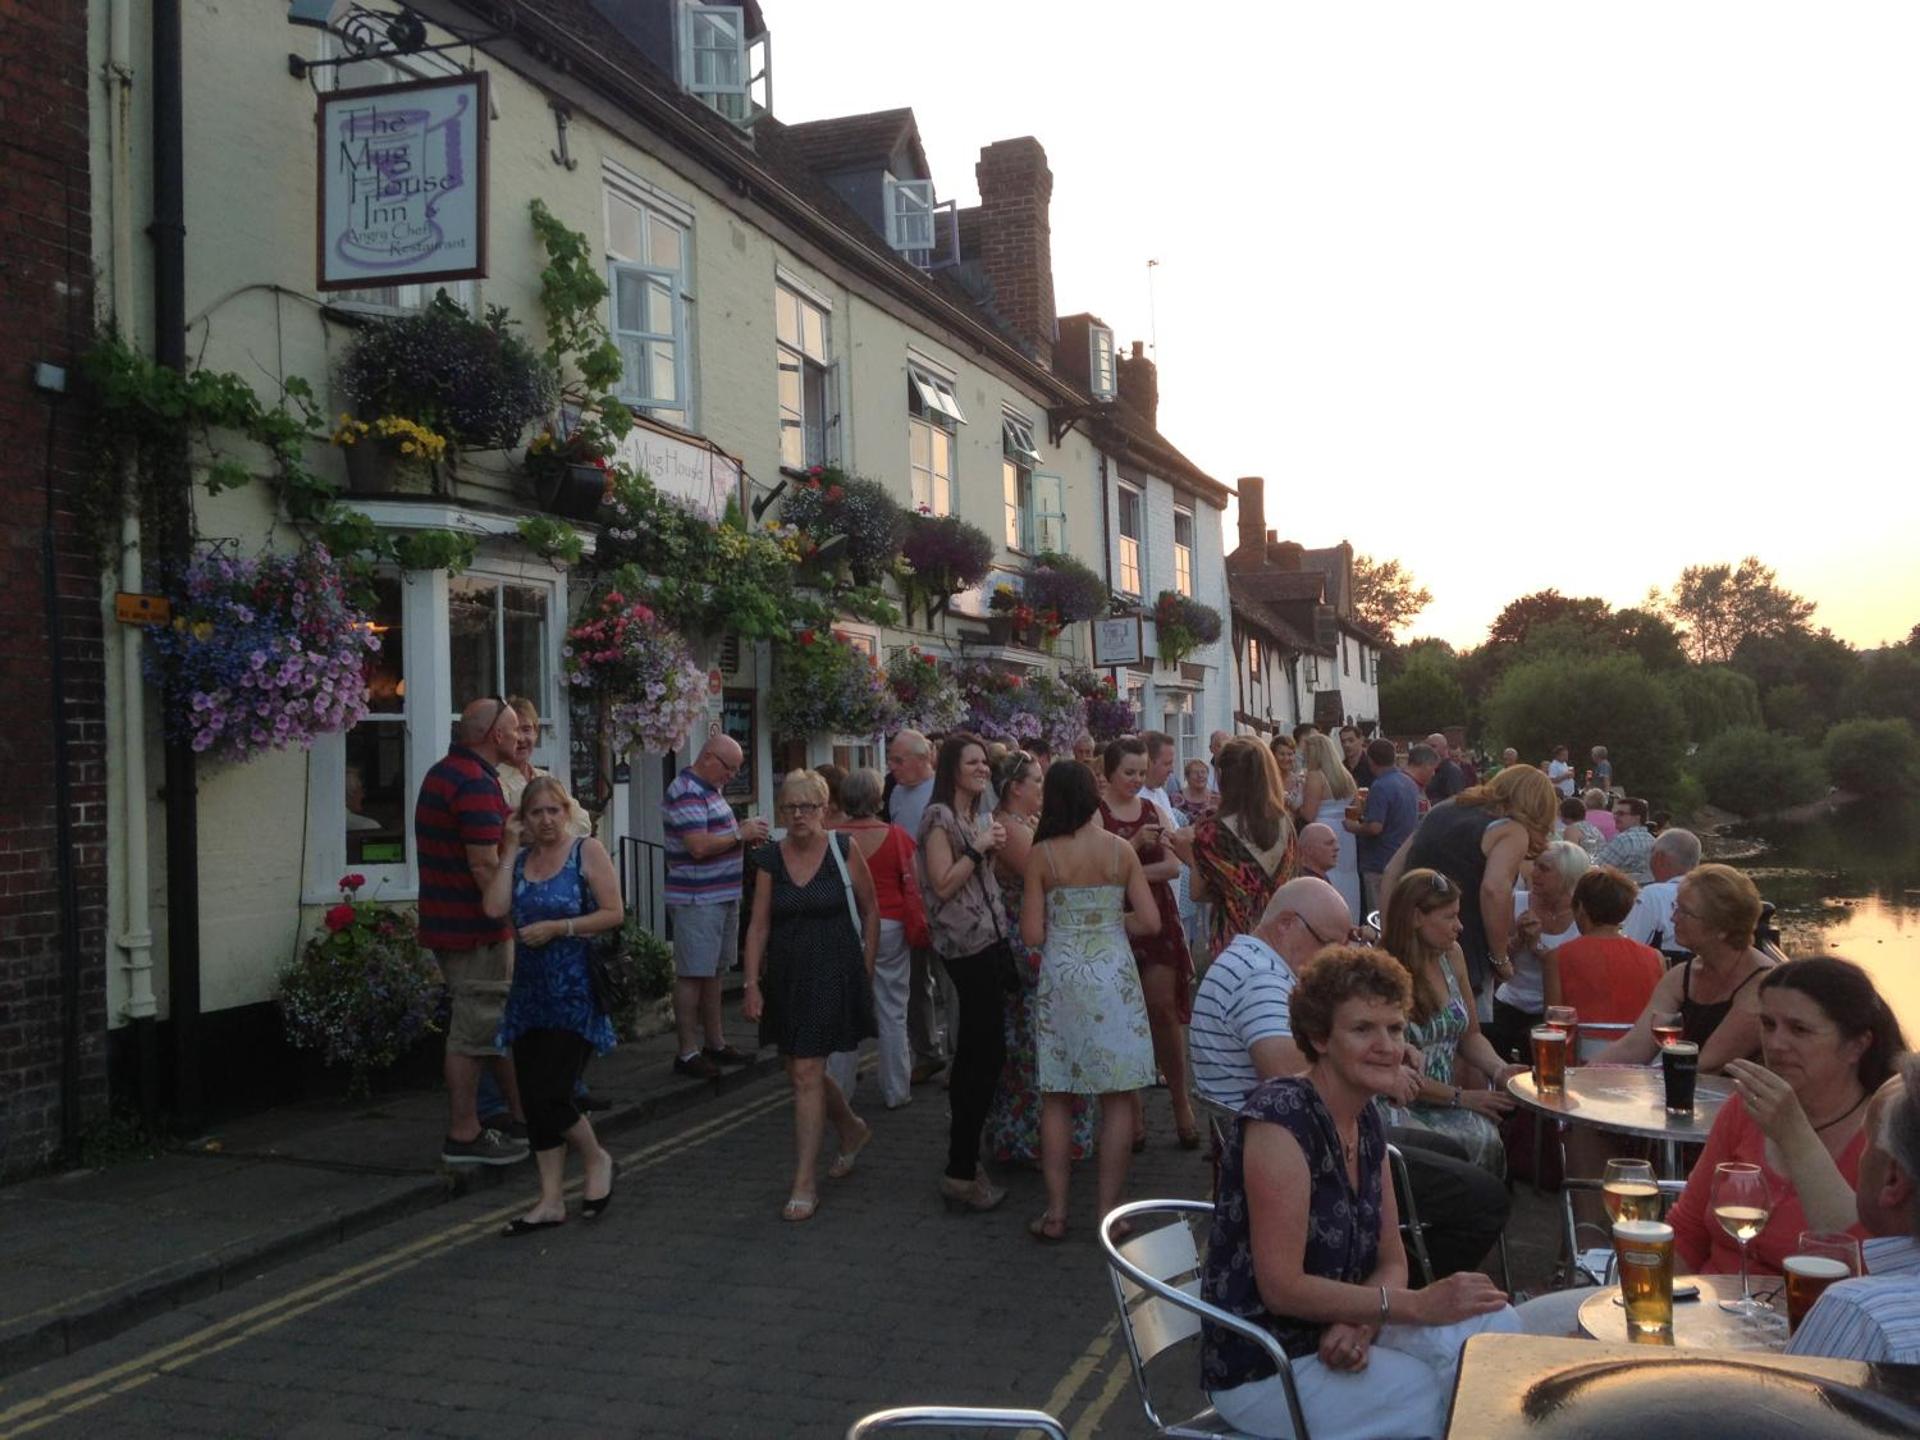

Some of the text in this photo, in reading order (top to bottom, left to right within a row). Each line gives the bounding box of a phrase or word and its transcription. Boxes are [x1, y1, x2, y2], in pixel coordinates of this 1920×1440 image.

[338, 105, 407, 143] The
[340, 138, 412, 174] Mug
[351, 165, 455, 204] House
[364, 195, 407, 230] Inn
[390, 237, 466, 257] Restaurant
[634, 438, 664, 477] Mug
[665, 447, 704, 481] House
